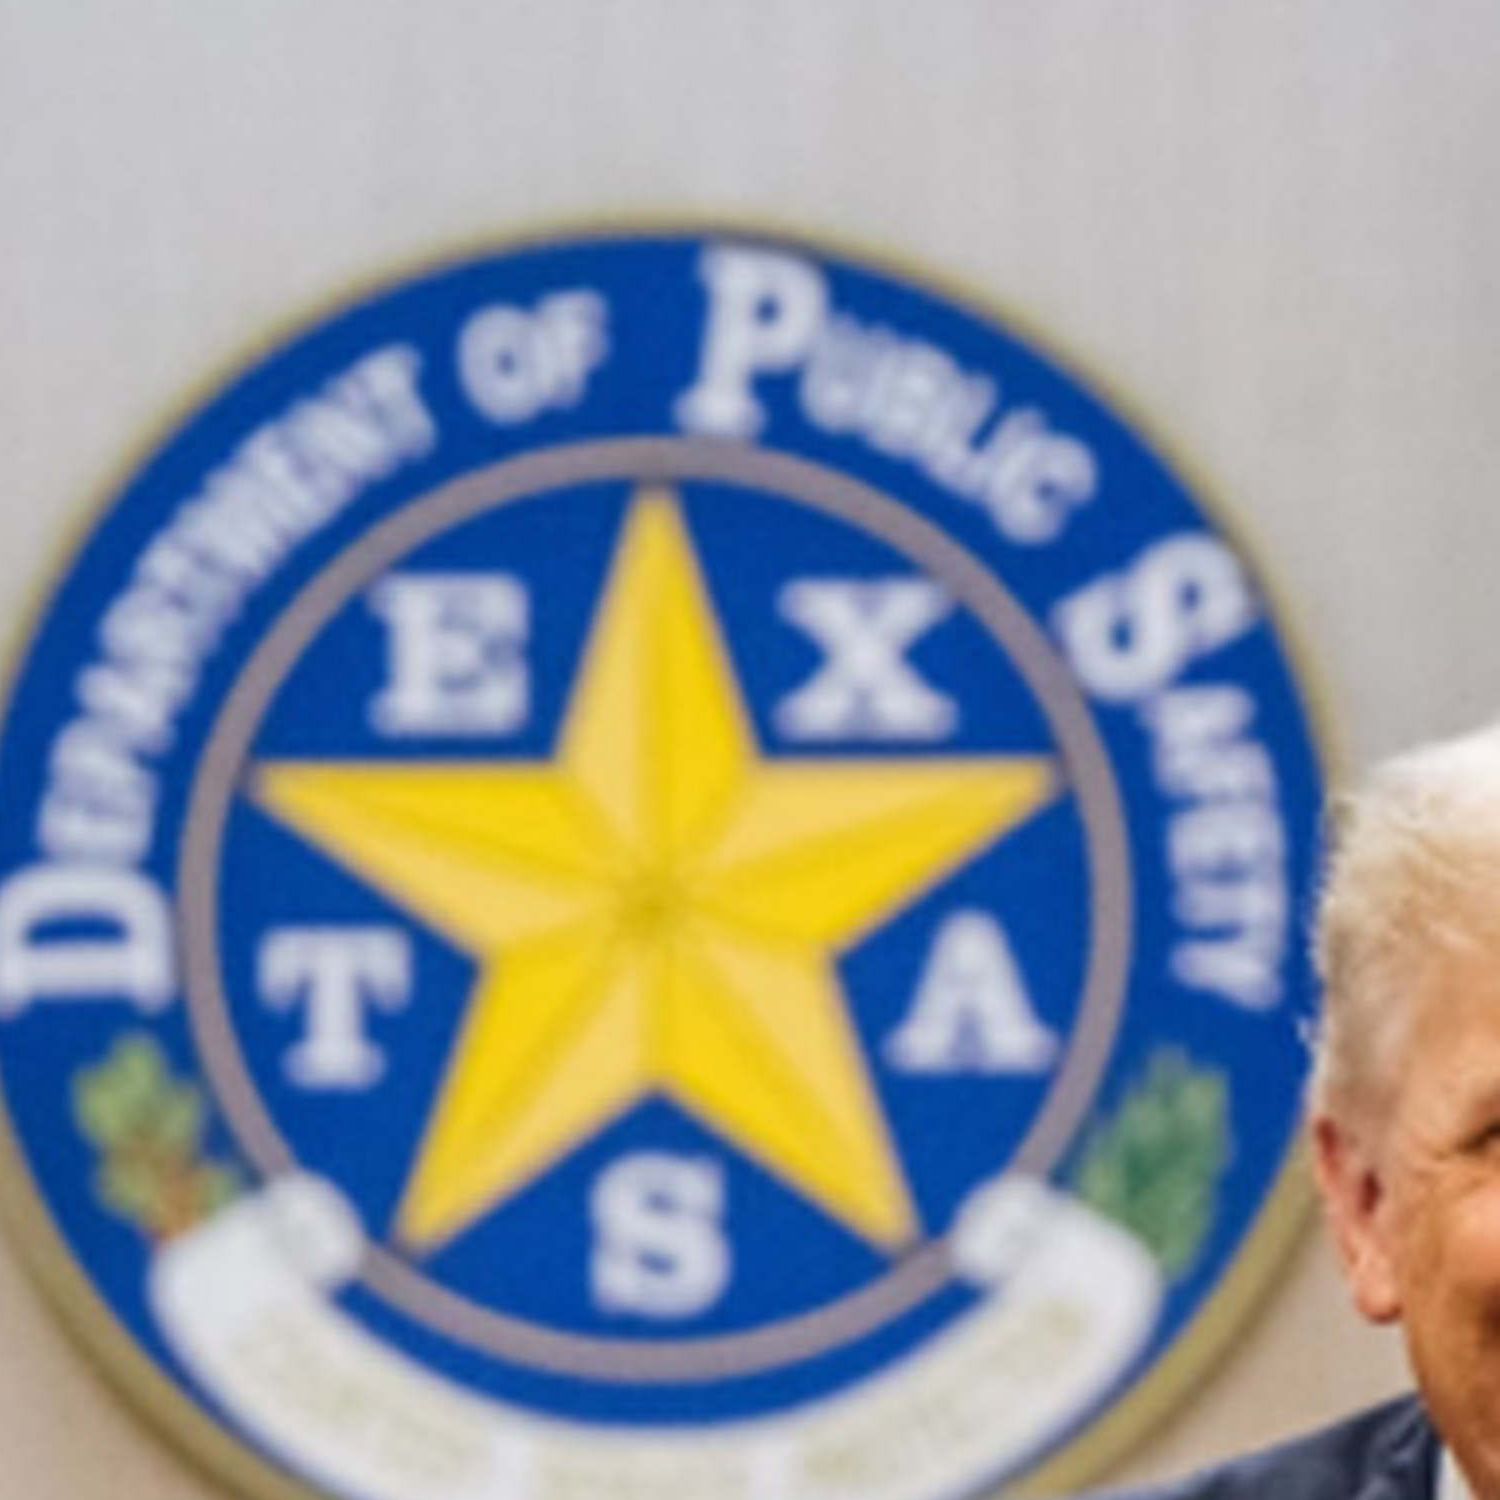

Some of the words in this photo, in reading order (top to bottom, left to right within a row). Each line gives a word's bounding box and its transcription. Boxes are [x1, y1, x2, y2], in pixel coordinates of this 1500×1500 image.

[459, 291, 604, 420] OF
[677, 245, 1096, 541] PUBLIC
[1054, 533, 1288, 1006] SAFETY
